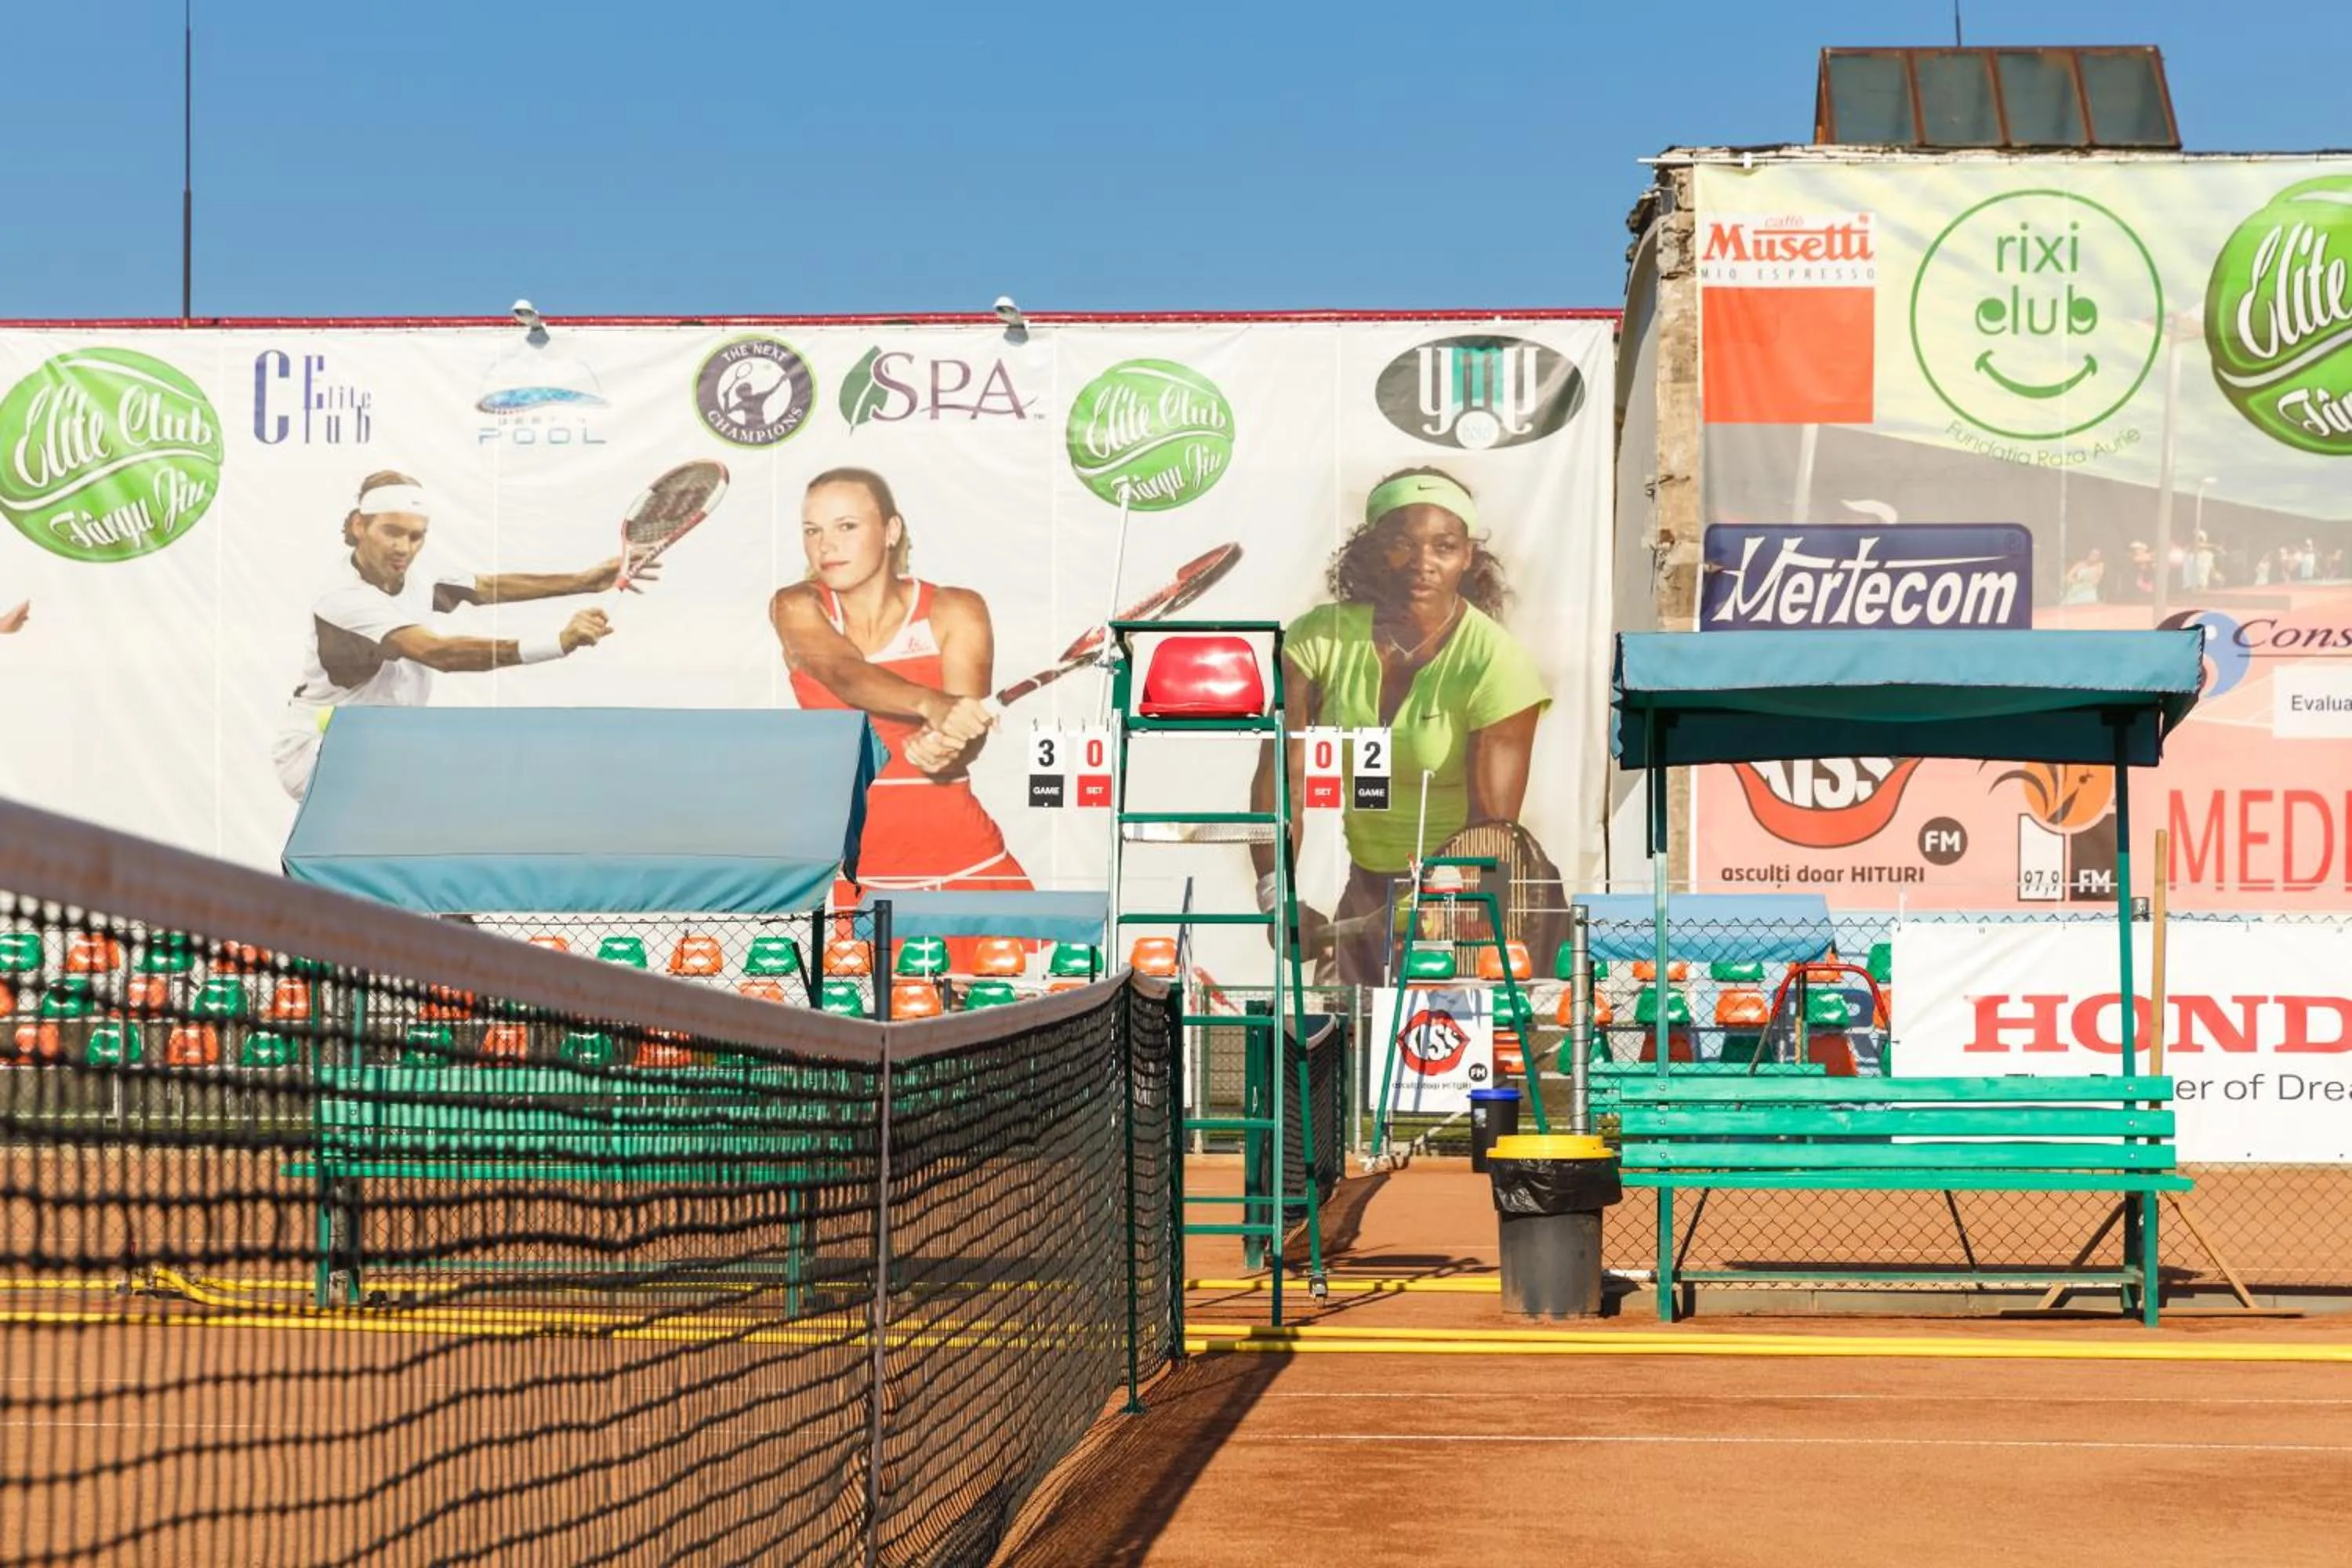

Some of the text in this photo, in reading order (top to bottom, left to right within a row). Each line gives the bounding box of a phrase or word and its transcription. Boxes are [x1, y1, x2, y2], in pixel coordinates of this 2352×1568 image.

[1702, 219, 1875, 262] Musetti
[1997, 222, 2080, 273] rixi
[1701, 267, 1875, 280] MIO ESPRESSO
[2238, 220, 2352, 358] Elite
[721, 343, 787, 362] THE NEXT
[871, 350, 1027, 422] SPA
[14, 383, 213, 488] Elite Club
[707, 407, 804, 442] CHAMPIONS
[1087, 383, 1226, 459] Elite Club
[478, 427, 606, 445] POOL
[1711, 535, 2020, 625] Vertecom
[1037, 738, 1104, 768] 3 0
[1315, 740, 1381, 768] 0 2
[1033, 786, 1061, 796] GAME
[1357, 787, 1385, 797] GAME
[1924, 830, 1961, 853] FM
[1796, 865, 1845, 884] doar
[1851, 866, 1926, 884] HITURI
[2023, 868, 2112, 896] 97,9 FM
[1962, 993, 2352, 1054] HOND
[2223, 1074, 2266, 1101] of
[2278, 1076, 2352, 1102] Dre
